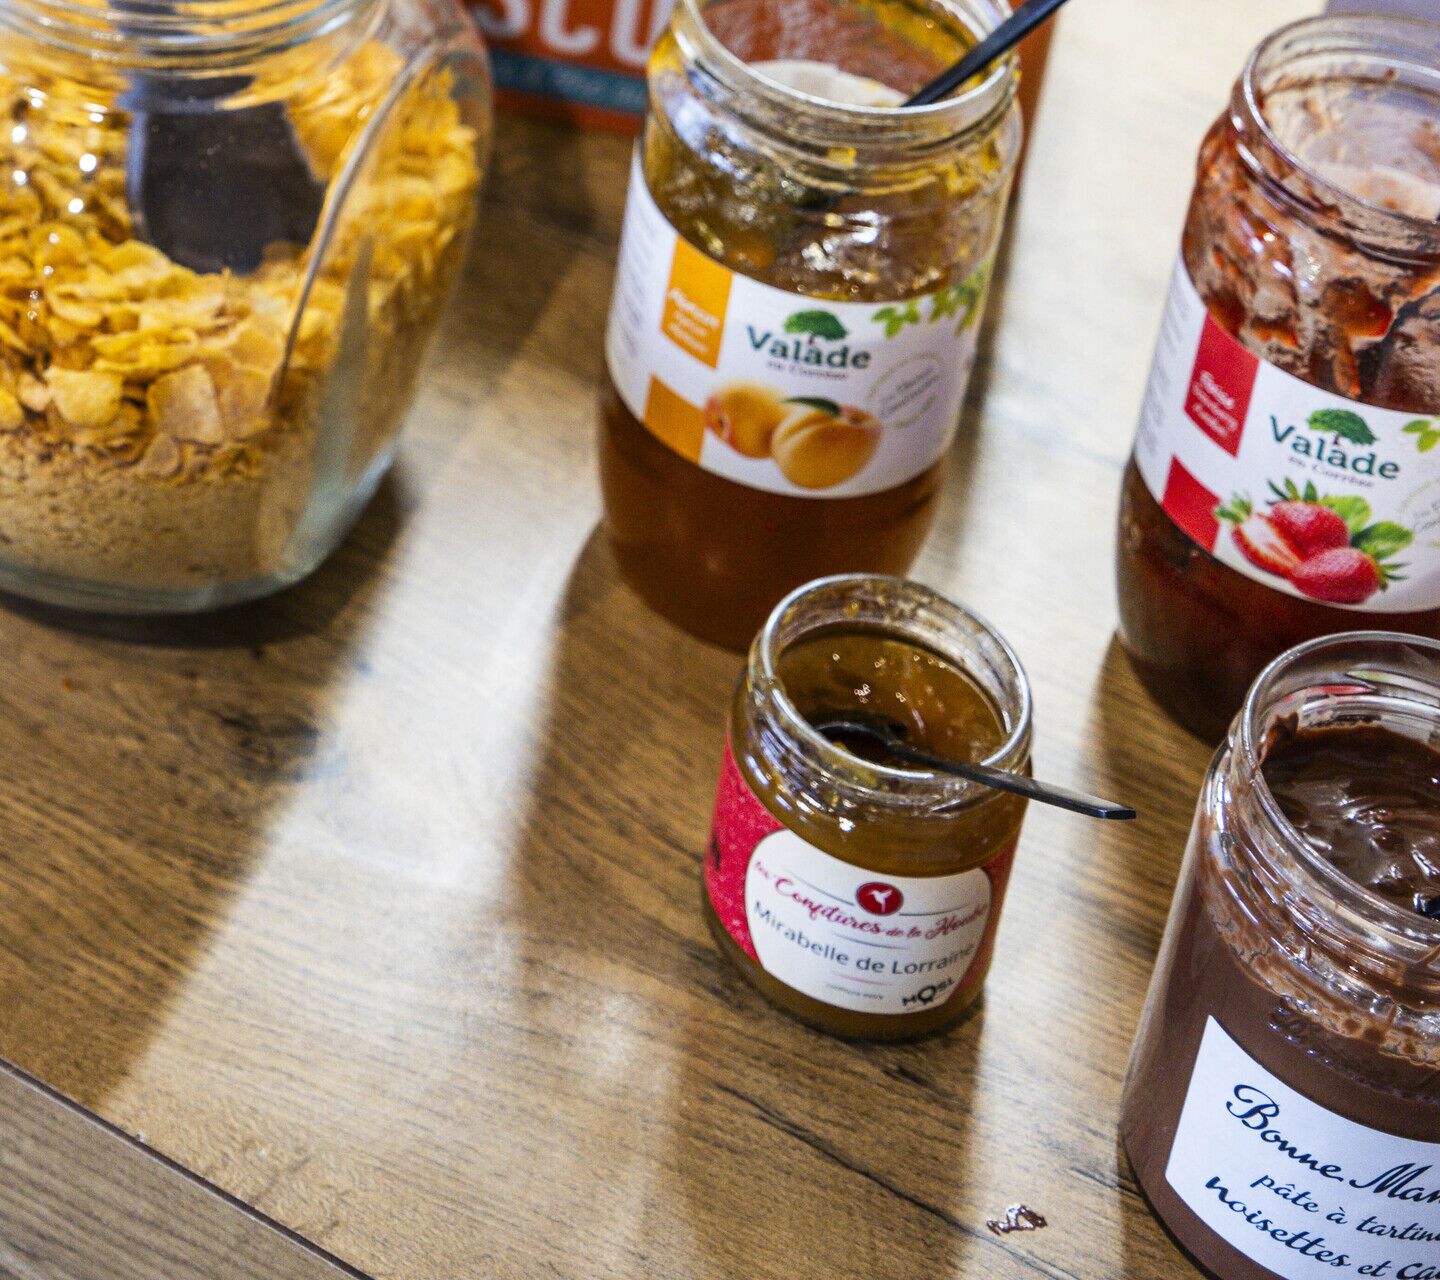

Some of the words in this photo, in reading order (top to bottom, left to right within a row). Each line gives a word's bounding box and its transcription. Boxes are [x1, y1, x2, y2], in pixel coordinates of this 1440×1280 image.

[746, 324, 872, 370] Valade
[1270, 414, 1401, 480] Valade
[754, 900, 850, 967] Mirabelle
[856, 956, 886, 974] de
[891, 942, 977, 976] Lorraine
[1226, 1083, 1345, 1183] Bonne
[1205, 1176, 1351, 1268] noisettes
[1357, 1260, 1392, 1277] et
[1249, 1174, 1320, 1213] pâte
[1326, 1206, 1348, 1225] à
